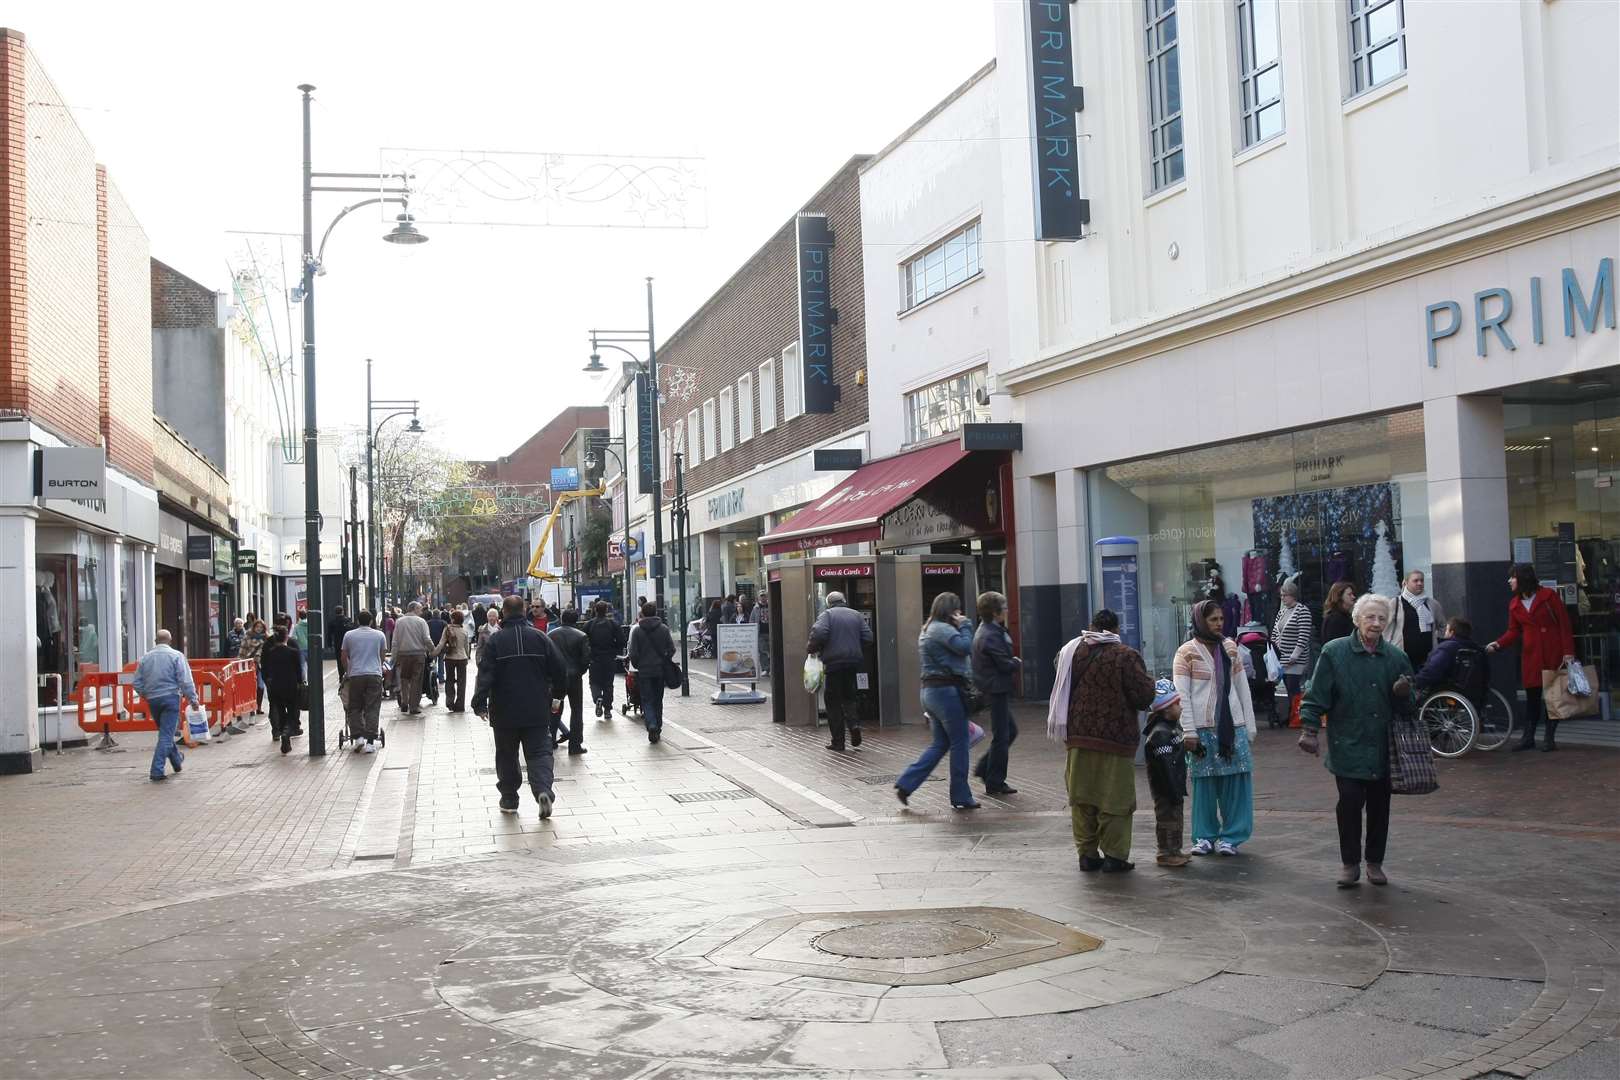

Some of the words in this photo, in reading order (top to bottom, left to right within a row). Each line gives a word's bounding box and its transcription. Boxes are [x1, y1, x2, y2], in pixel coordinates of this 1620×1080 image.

[1038, 2, 1072, 190] PRIMARK
[804, 249, 828, 380] PRIMARK
[1425, 256, 1617, 368] PRIM
[48, 480, 98, 488] BURTON
[1296, 455, 1345, 472] PRIMARK
